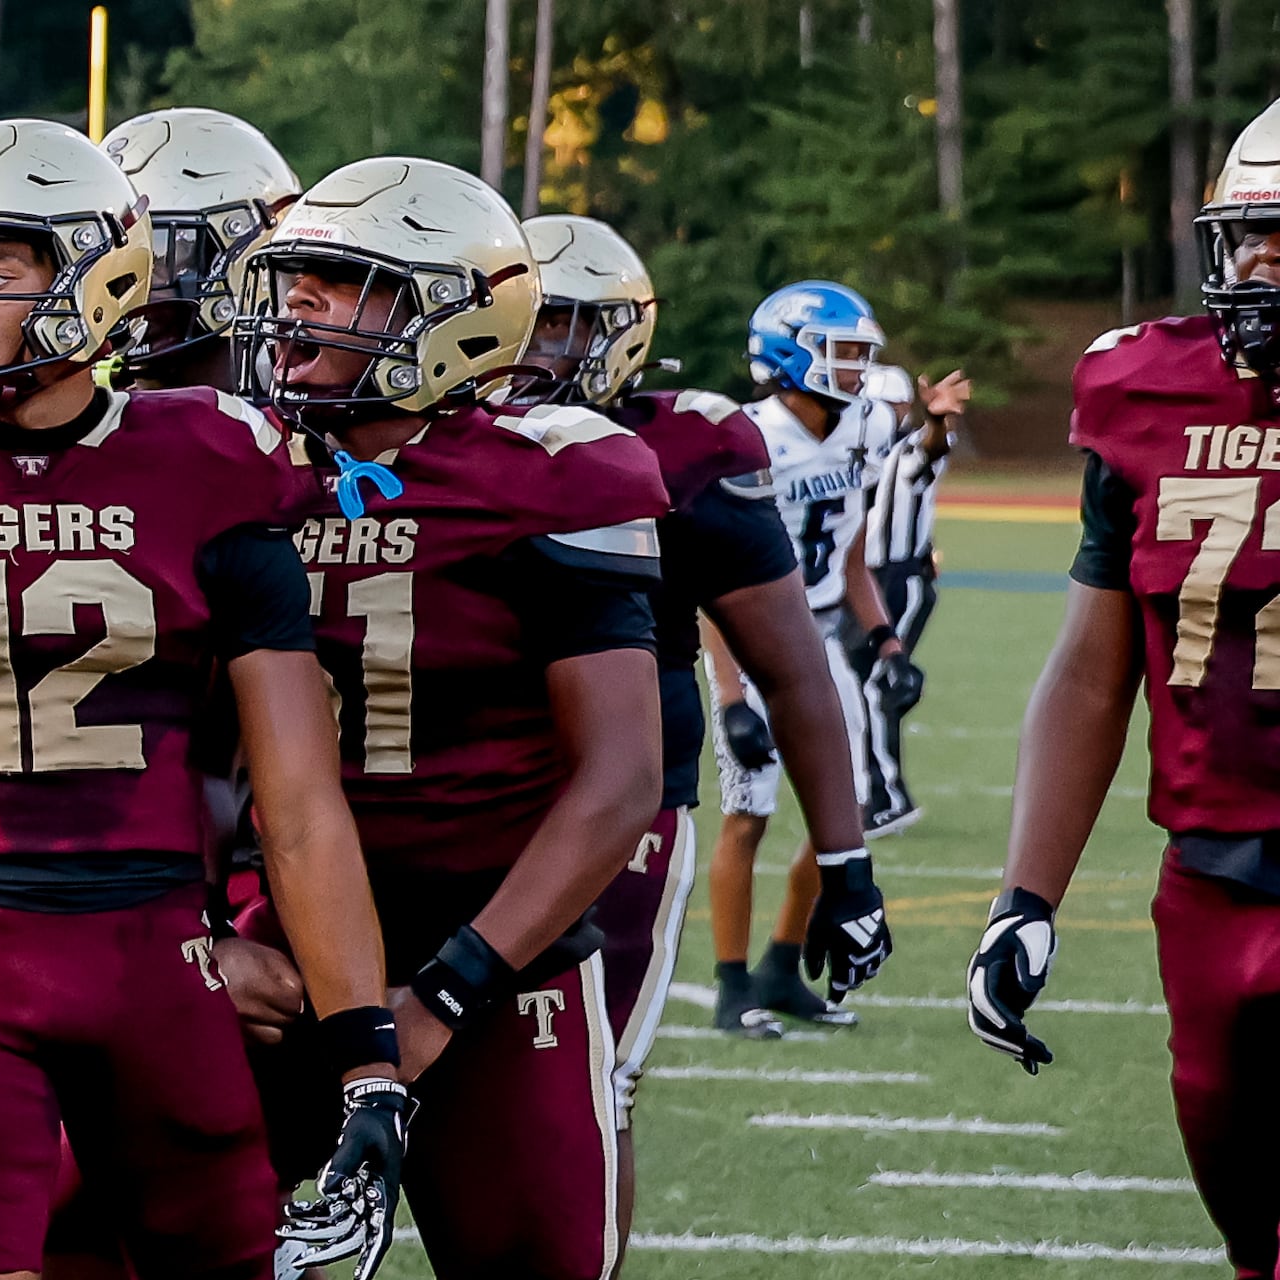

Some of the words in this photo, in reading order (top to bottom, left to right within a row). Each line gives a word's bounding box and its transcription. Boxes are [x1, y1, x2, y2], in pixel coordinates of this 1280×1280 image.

[292, 517, 419, 564] GERS
[1156, 475, 1280, 690] 7
[308, 571, 414, 774] 1
[517, 989, 565, 1049] T
